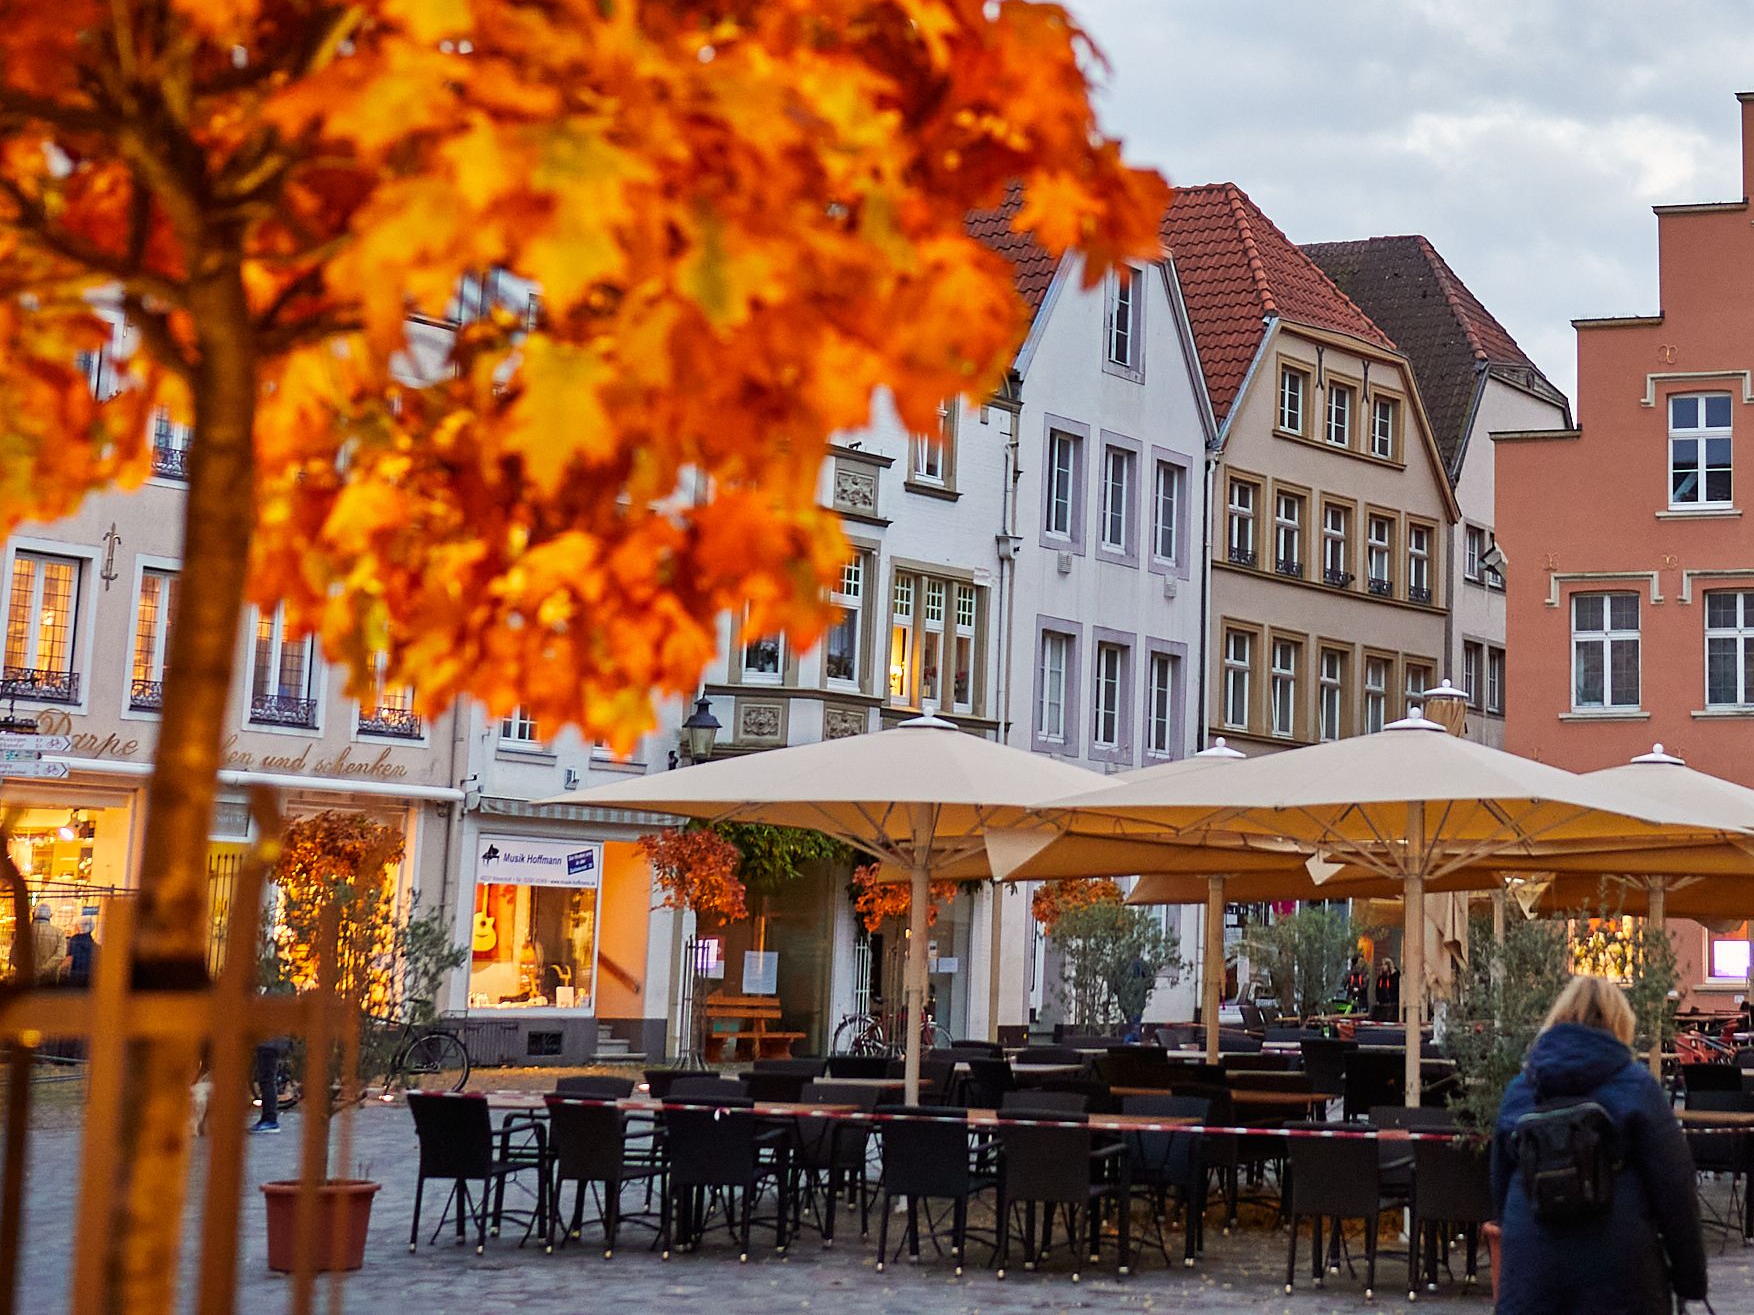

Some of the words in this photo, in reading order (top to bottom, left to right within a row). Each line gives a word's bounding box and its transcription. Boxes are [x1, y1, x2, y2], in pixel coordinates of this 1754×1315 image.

[261, 743, 307, 771] und
[313, 746, 408, 777] schenken
[503, 852, 525, 864] Musik
[526, 853, 562, 866] Hoffmann
